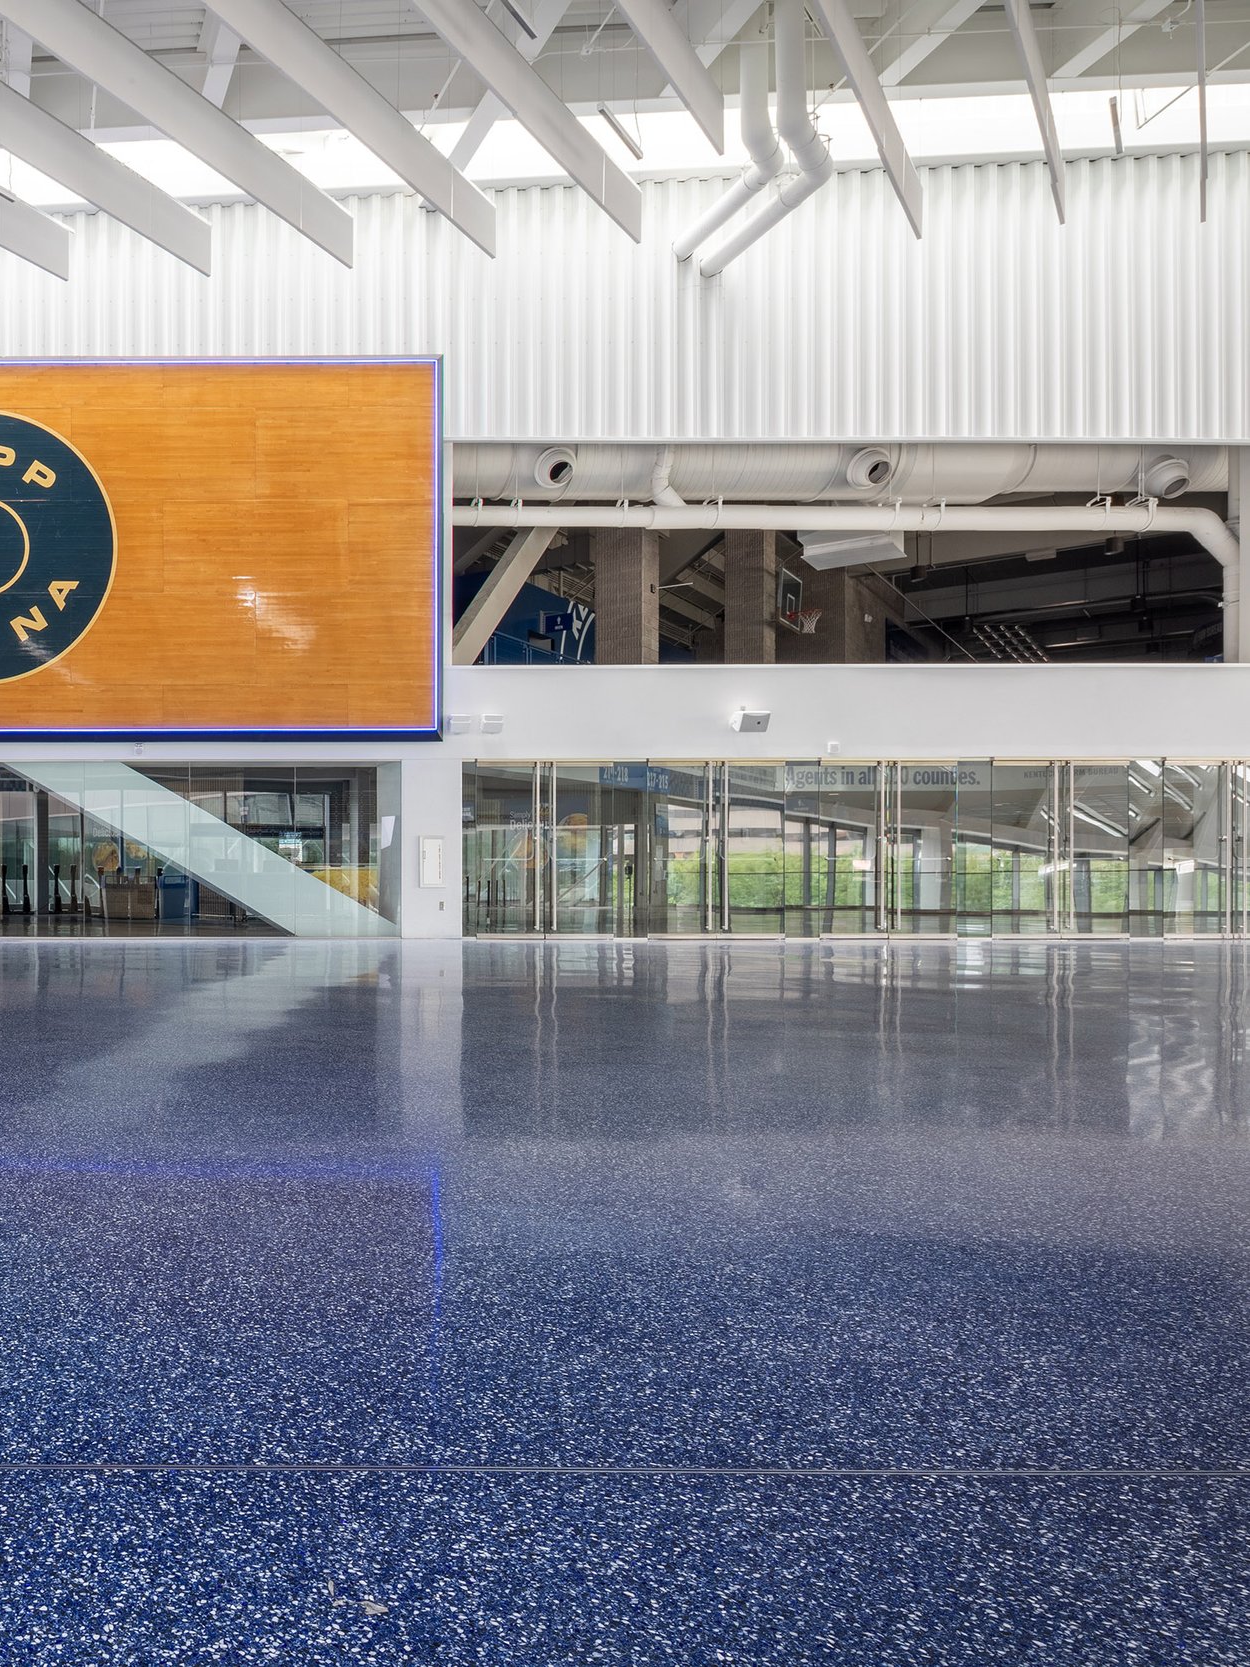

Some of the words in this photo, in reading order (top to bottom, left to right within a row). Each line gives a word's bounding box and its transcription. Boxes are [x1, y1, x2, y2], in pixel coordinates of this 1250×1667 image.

[785, 766, 837, 789] Agents
[841, 766, 854, 784] in
[858, 766, 876, 785] all
